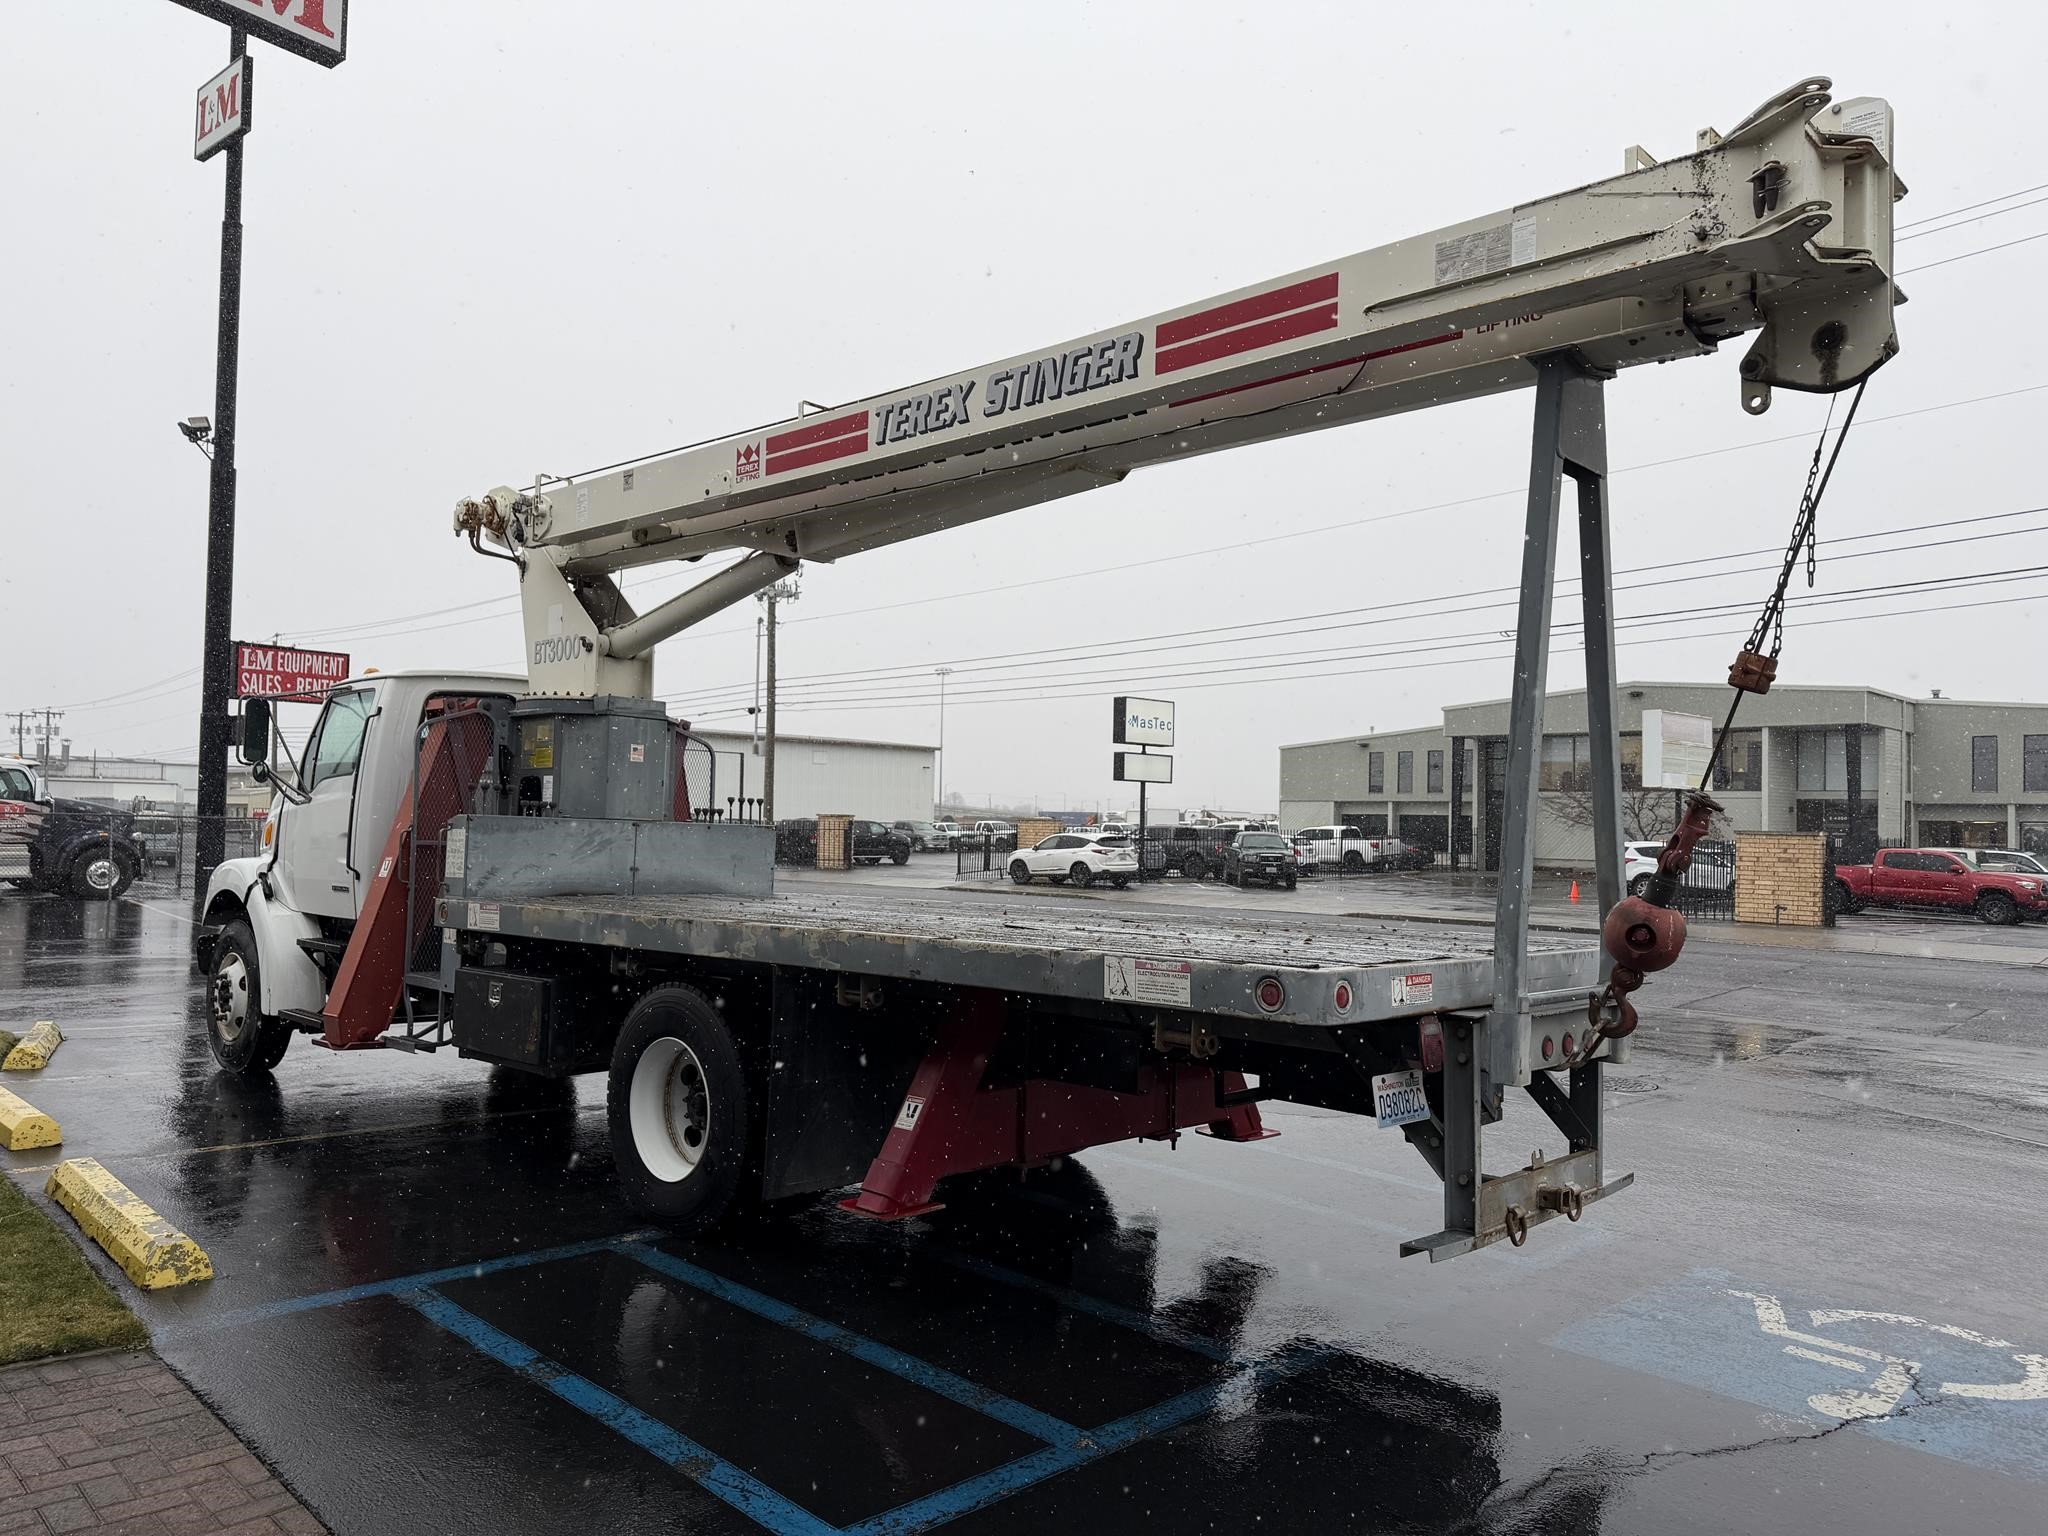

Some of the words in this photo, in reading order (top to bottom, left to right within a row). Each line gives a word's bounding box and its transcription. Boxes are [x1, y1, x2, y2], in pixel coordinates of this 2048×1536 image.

[198, 72, 239, 142] L&M
[875, 380, 976, 446] TEREX
[983, 331, 1144, 418] STINGER
[737, 461, 759, 474] TEREX
[735, 472, 760, 484] LIFTING
[534, 633, 581, 665] BT3000
[241, 648, 275, 671] L&M
[276, 651, 345, 677] EQUIPMENT
[241, 672, 282, 694] SALES
[1131, 714, 1172, 731] MasTec
[1137, 970, 1171, 978] ELECTROCUTION
[1412, 975, 1431, 984] DANGER
[1377, 1081, 1404, 1091] WASHINGTON
[1379, 1088, 1425, 1120] D98082C
